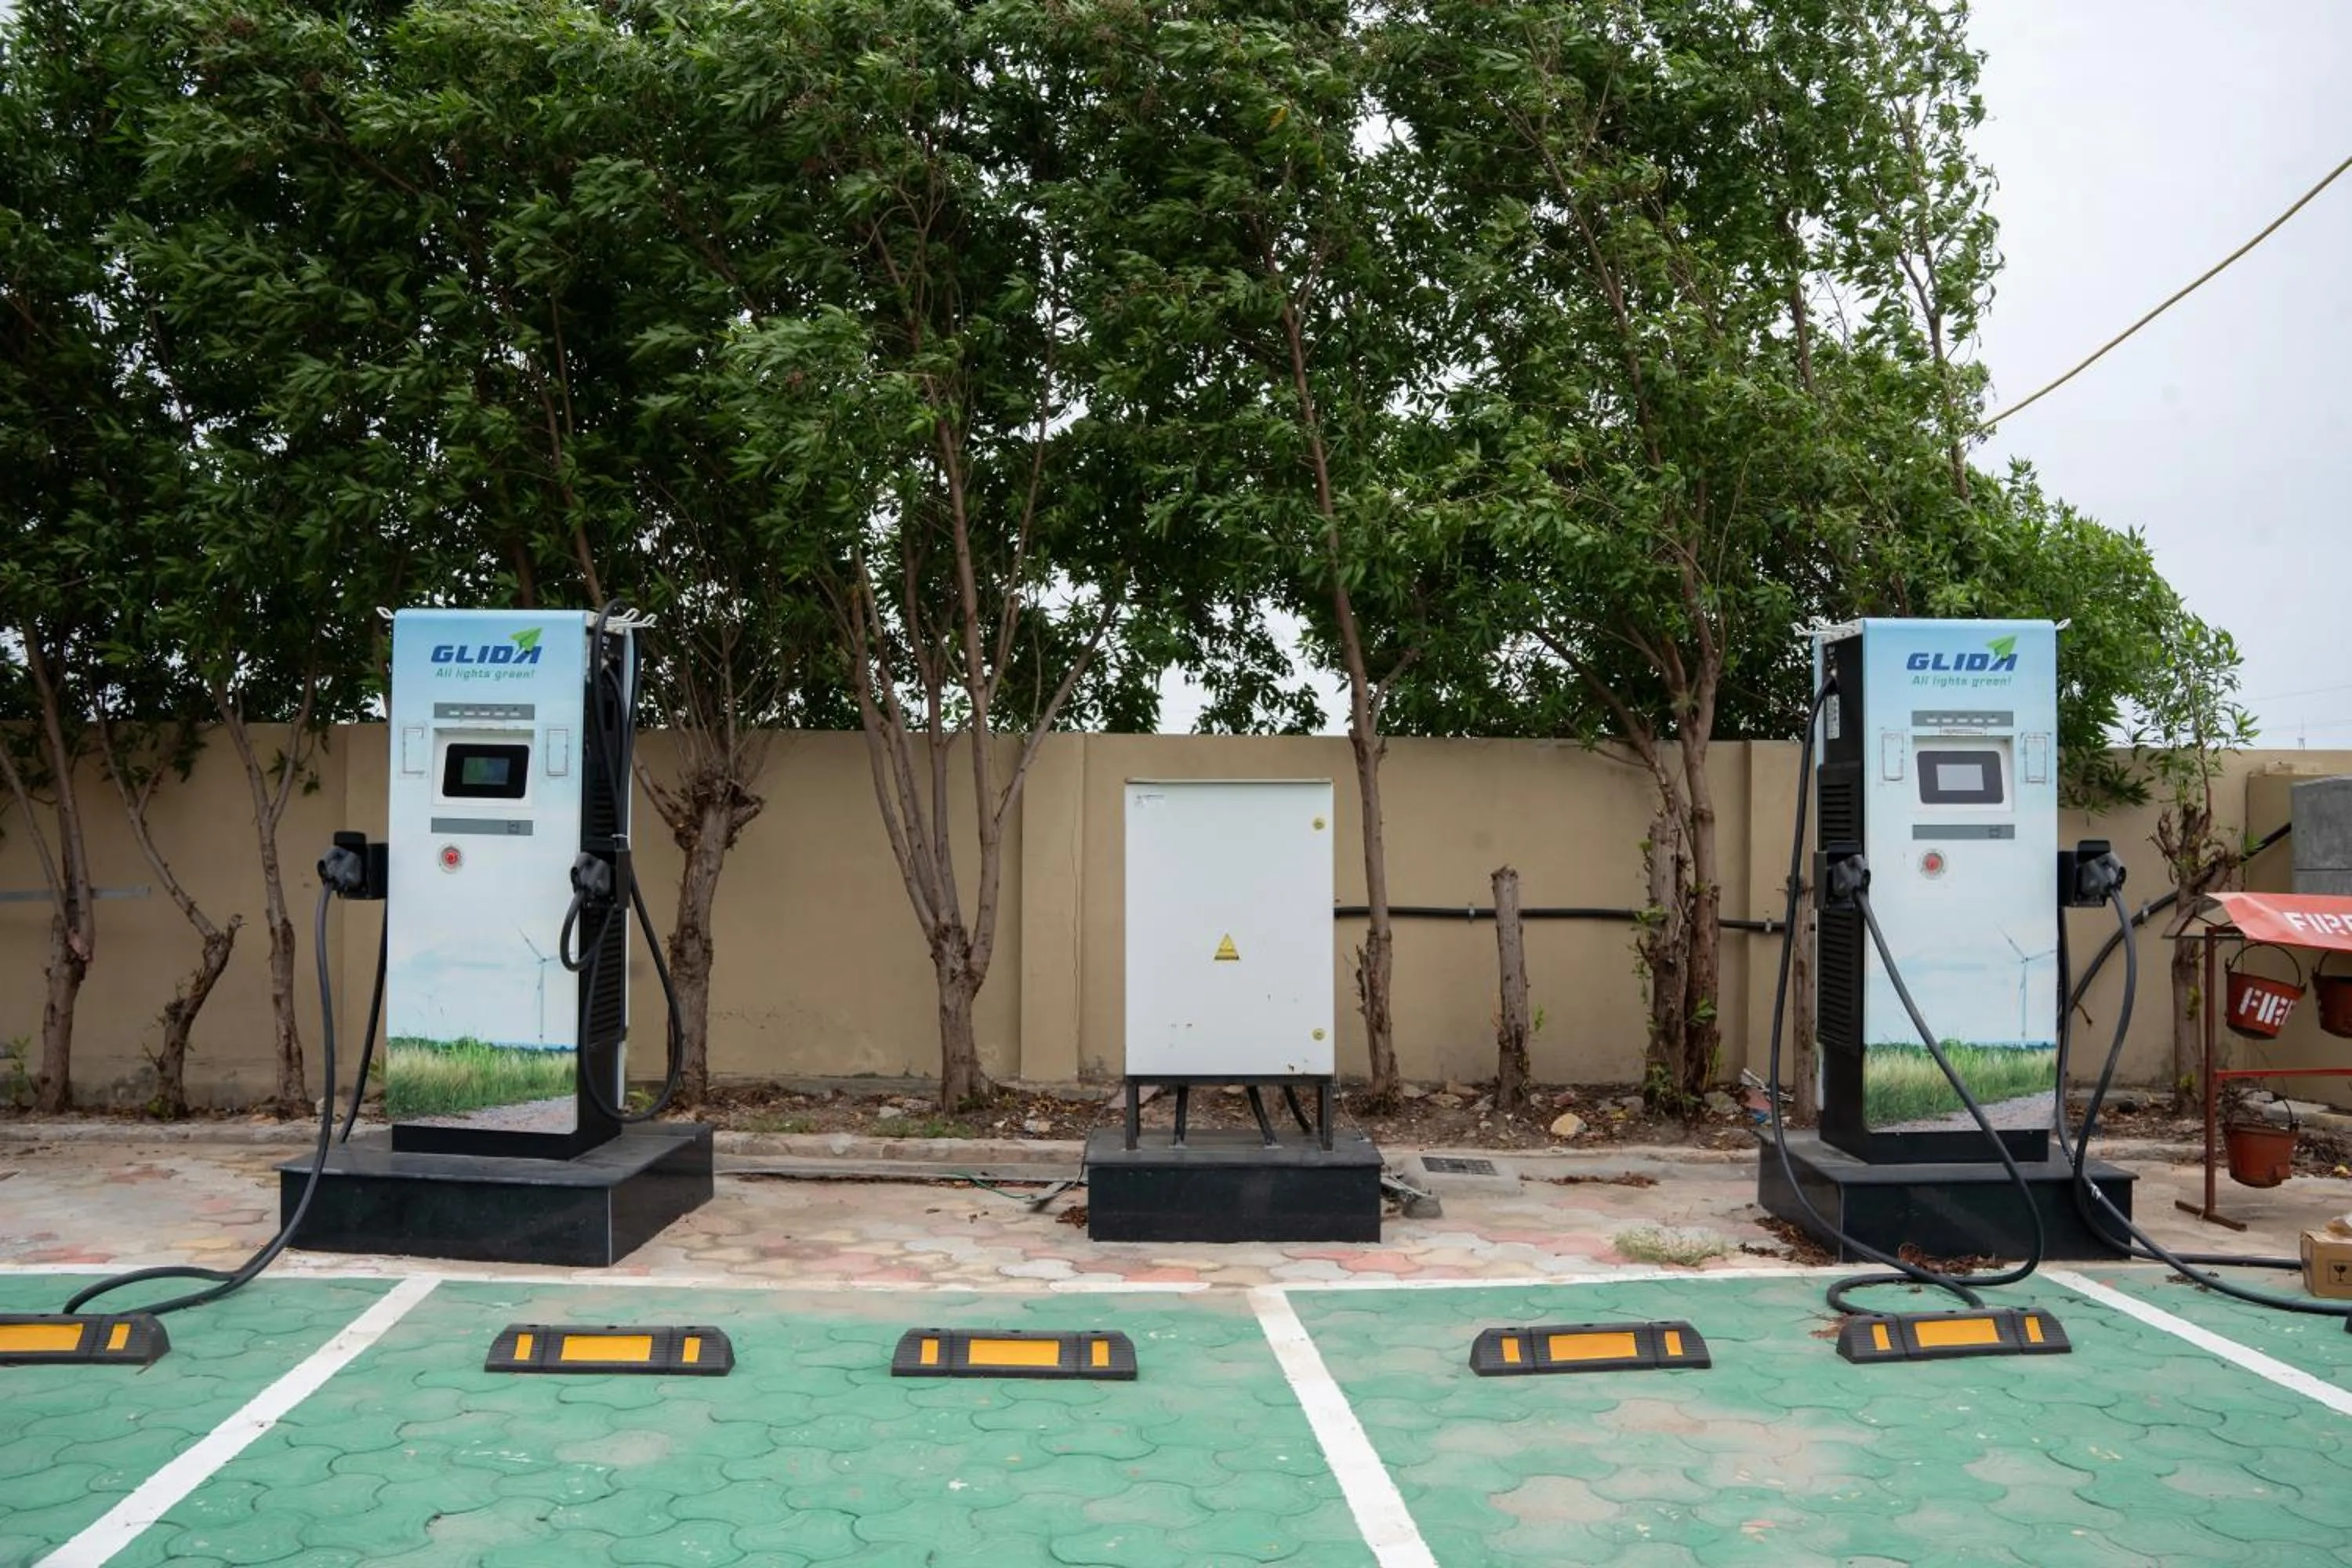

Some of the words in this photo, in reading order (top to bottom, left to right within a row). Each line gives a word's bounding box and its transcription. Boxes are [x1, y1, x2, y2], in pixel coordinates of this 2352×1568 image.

[430, 644, 543, 664] GLIDA
[1906, 652, 2018, 672] GLIDA
[435, 668, 452, 679] All
[456, 668, 491, 681] lights
[495, 669, 535, 681] green!
[1911, 675, 1929, 686] All
[1932, 676, 1968, 688] lights
[1971, 676, 2013, 688] green!
[2238, 986, 2295, 1027] FIR
